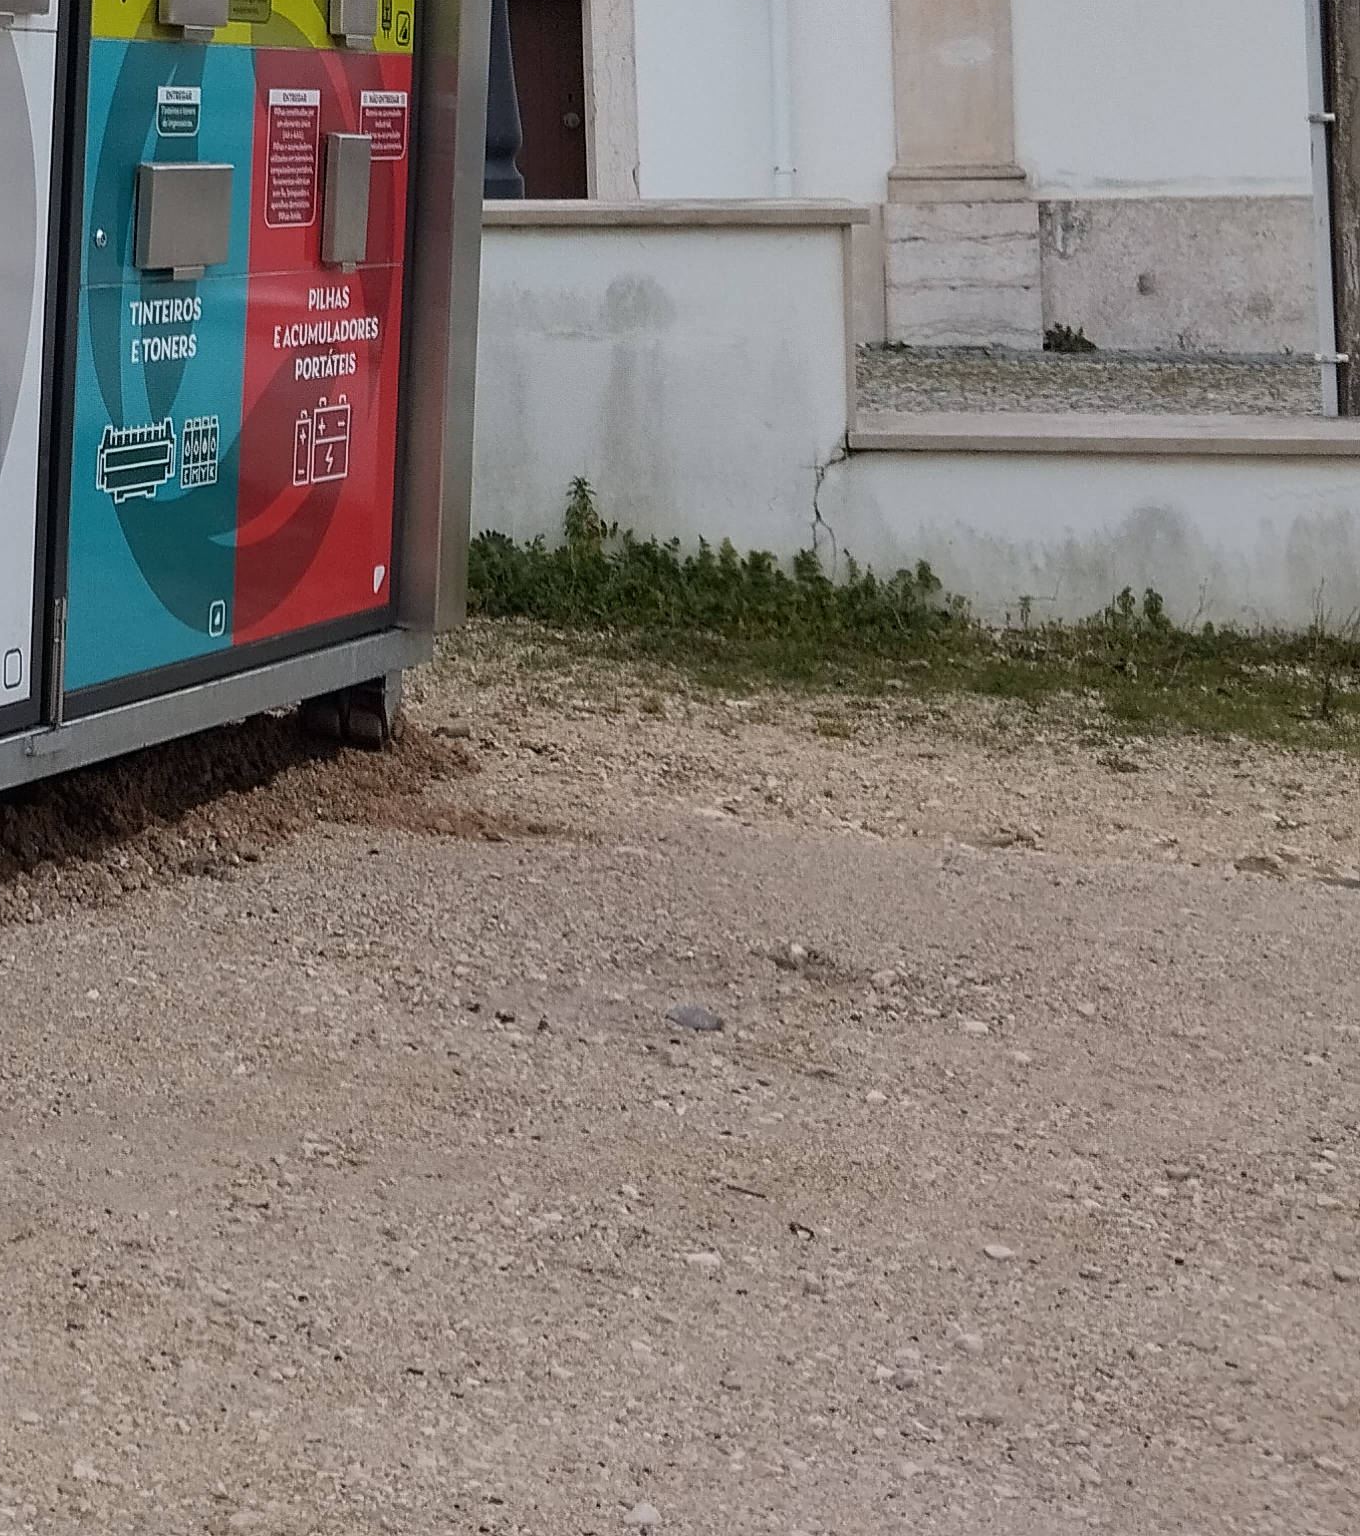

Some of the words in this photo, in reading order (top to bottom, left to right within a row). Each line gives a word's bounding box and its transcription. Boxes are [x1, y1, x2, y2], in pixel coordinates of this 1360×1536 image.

[130, 297, 202, 326] TINTEIROS
[308, 285, 350, 311] PILHAS
[273, 326, 281, 349] E
[283, 316, 379, 348] ACUMULADORES
[131, 340, 140, 363] E
[142, 334, 197, 362] TONERS
[295, 349, 356, 381] PORTÁTEIS
